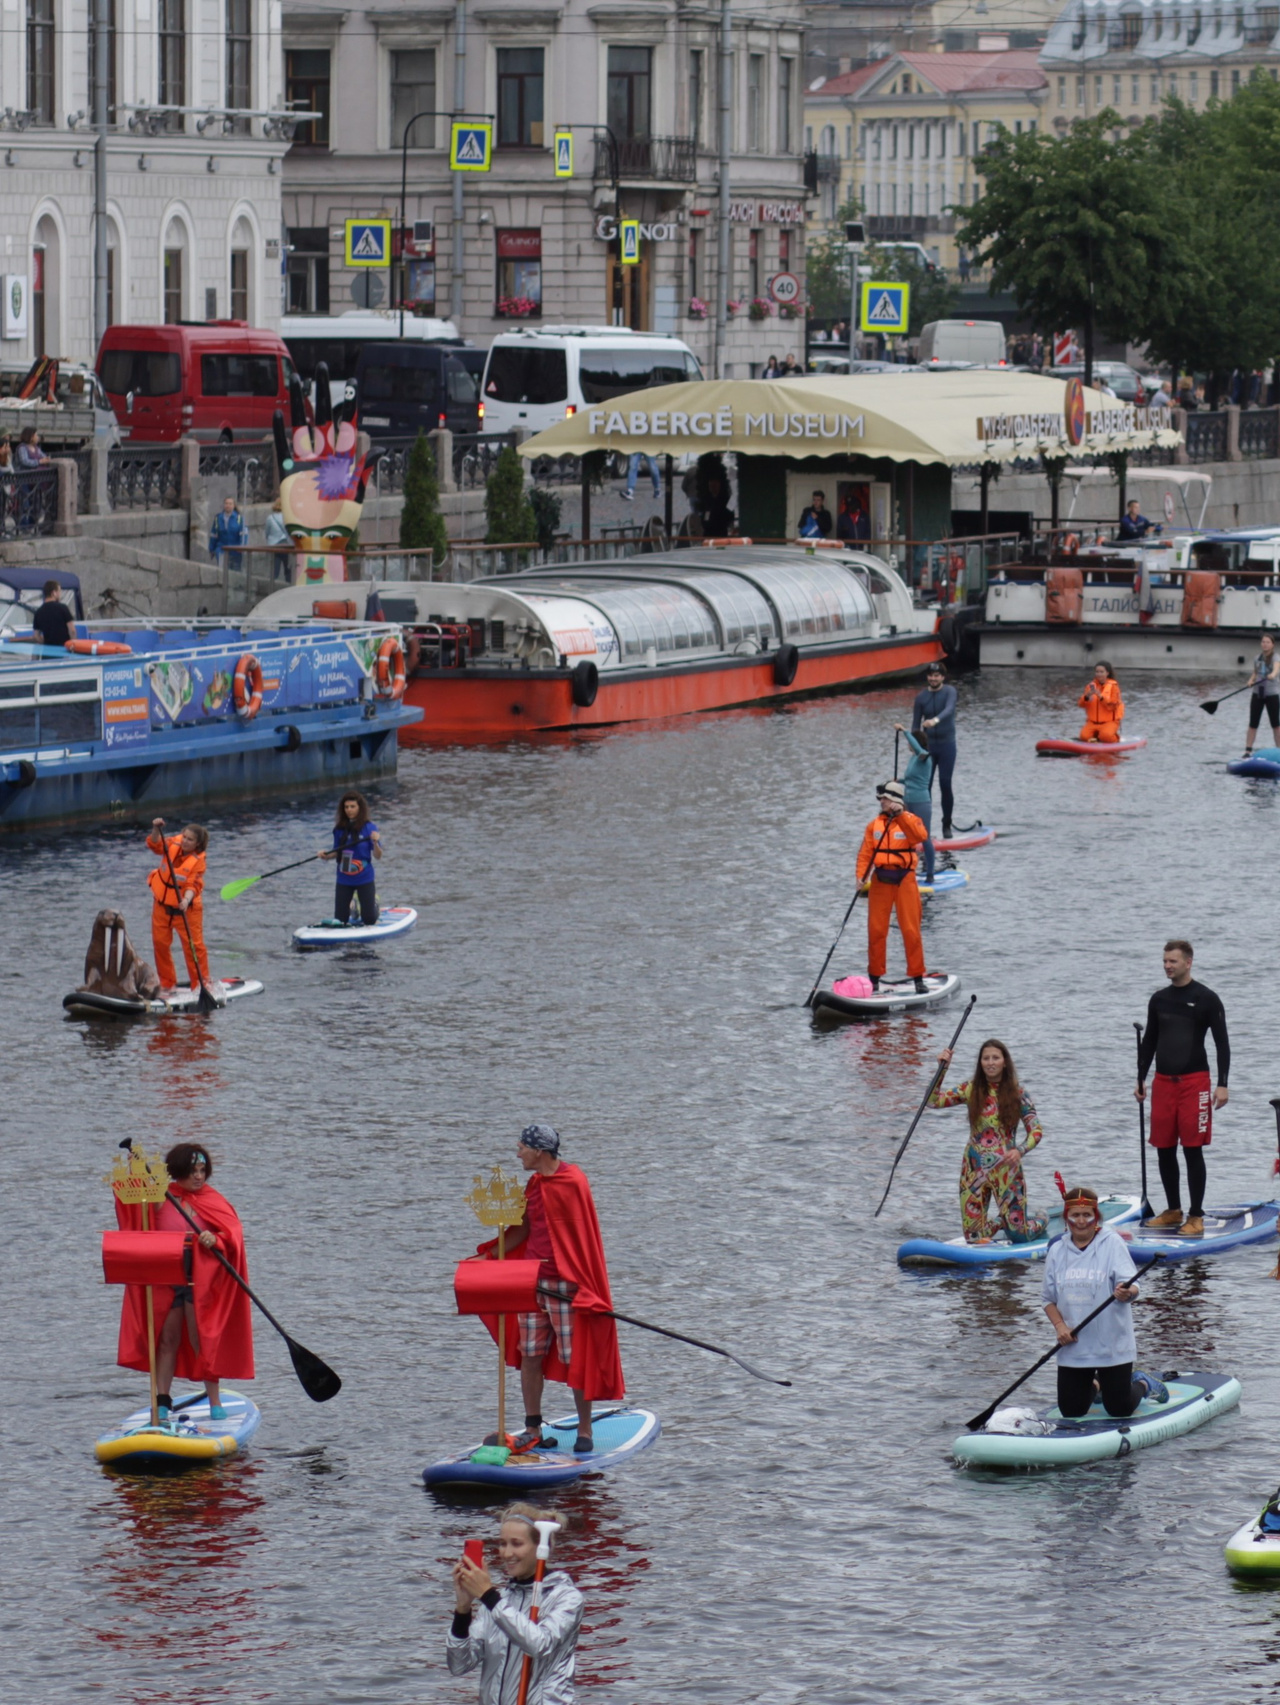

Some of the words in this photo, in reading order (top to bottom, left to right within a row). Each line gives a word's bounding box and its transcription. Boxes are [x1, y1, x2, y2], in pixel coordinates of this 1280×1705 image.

[730, 203, 754, 221] АЛОН
[597, 215, 677, 241] GNOT
[777, 282, 794, 294] 40
[588, 405, 733, 436] FABERGÉ
[745, 414, 865, 438] MUSEUM
[1137, 406, 1171, 430] MUSEUM
[1091, 598, 1175, 613] ТАЛИСАН
[1056, 1267, 1087, 1284] LNDON
[1088, 1268, 1106, 1283] CTY
